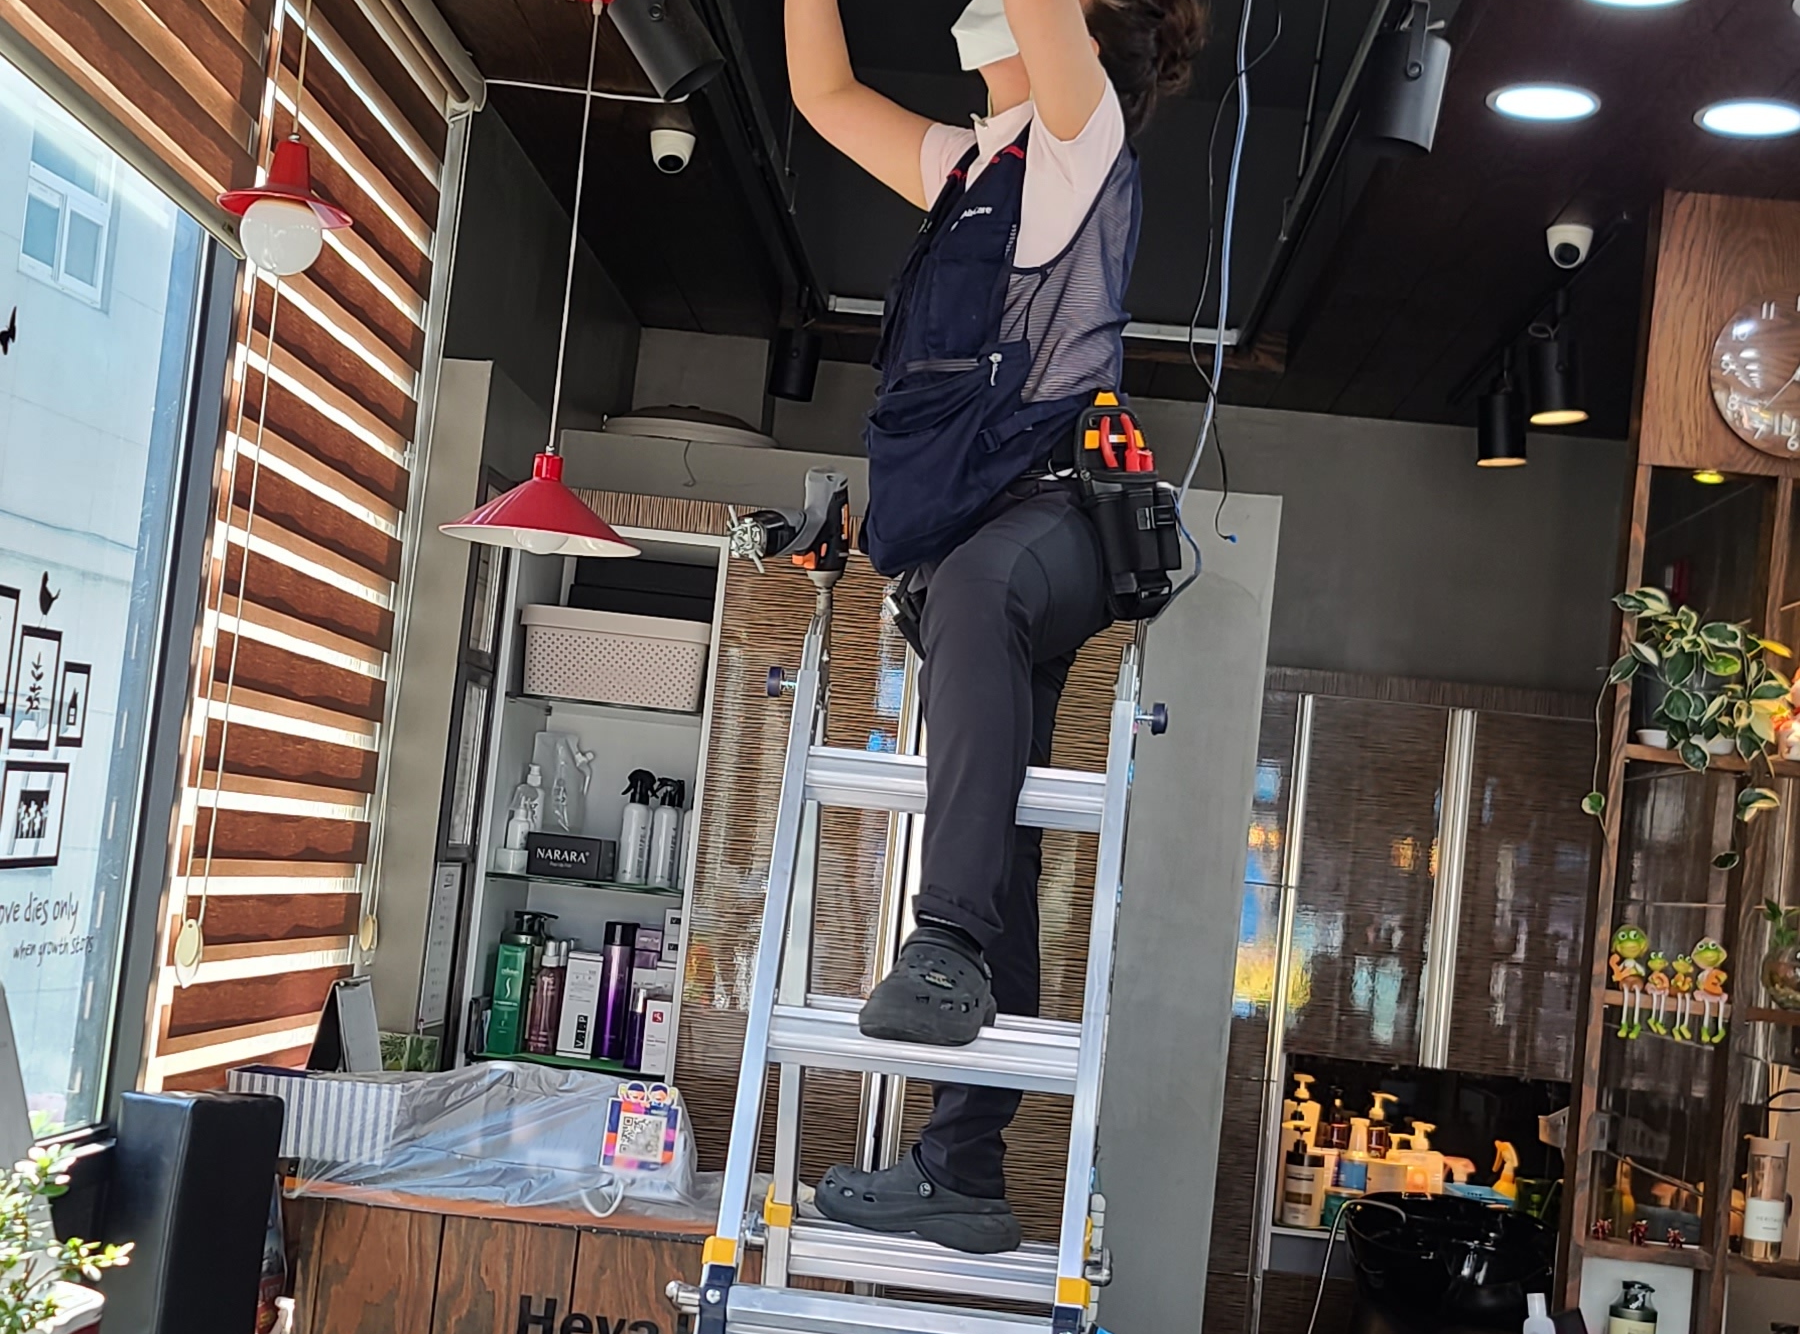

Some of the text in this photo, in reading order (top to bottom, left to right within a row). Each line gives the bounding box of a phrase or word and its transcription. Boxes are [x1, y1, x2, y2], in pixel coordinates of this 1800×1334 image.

[1786, 433, 1799, 452] 6
[536, 847, 587, 864] NARARA
[24, 891, 49, 926] dies
[53, 891, 79, 935] only
